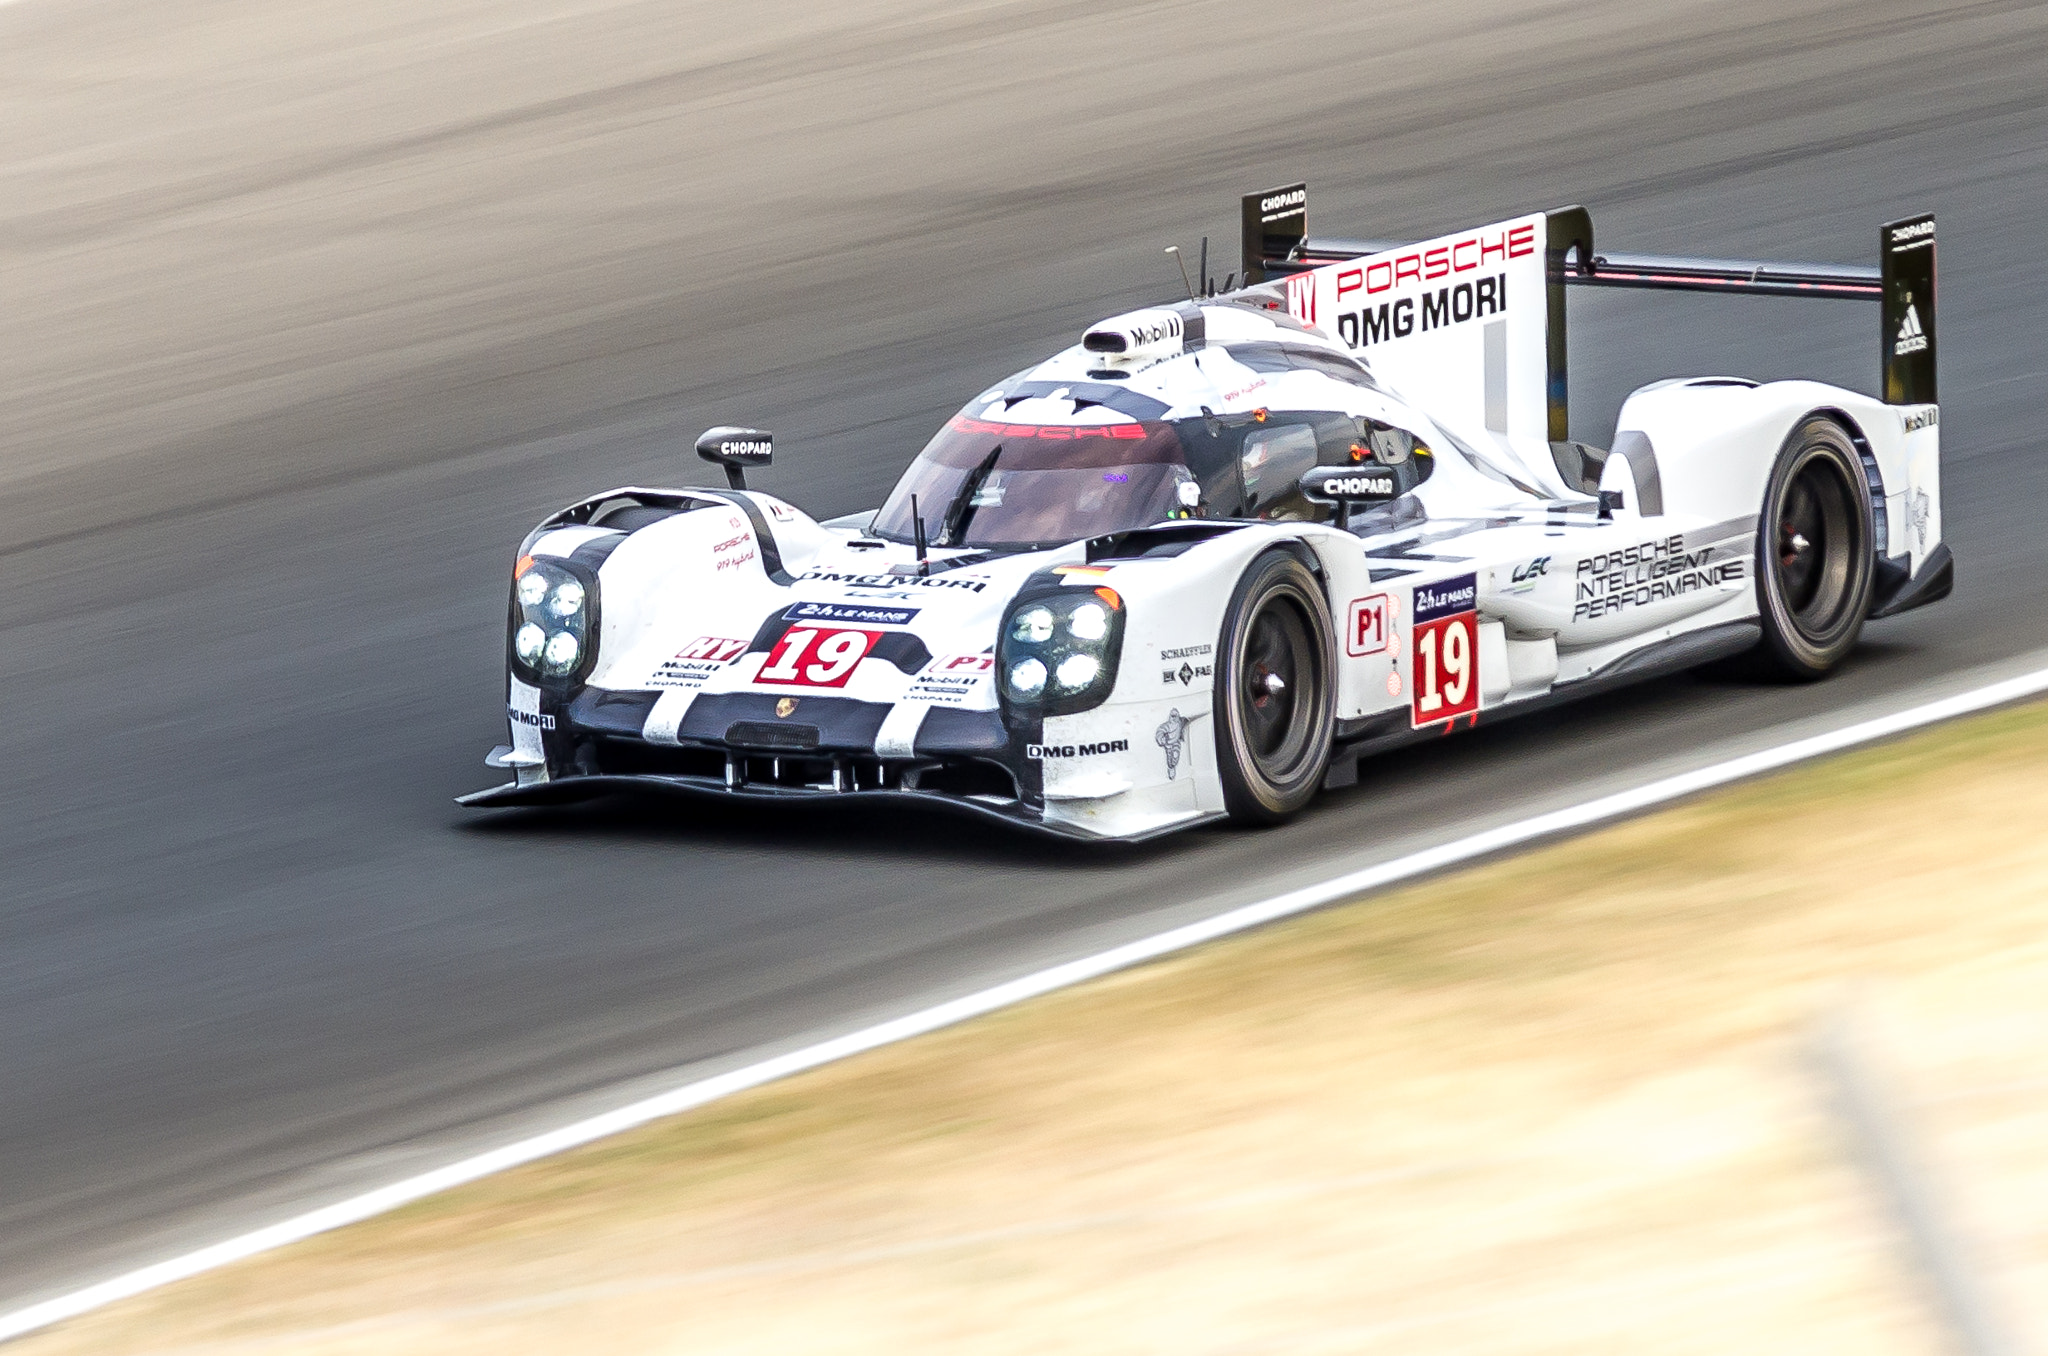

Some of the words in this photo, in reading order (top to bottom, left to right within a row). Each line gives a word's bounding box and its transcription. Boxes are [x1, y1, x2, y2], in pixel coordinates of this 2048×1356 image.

[1261, 189, 1305, 212] CHOPARD
[1337, 224, 1534, 303] PORSCHE
[1287, 273, 1316, 328] HY
[1338, 297, 1414, 350] DMG
[1421, 272, 1507, 332] MORI
[1130, 320, 1167, 348] Mobil
[721, 441, 772, 455] CHOPARD
[1323, 478, 1393, 495] CHOPARD
[1577, 534, 1684, 579] PORSCHE
[800, 571, 887, 586] DMG
[887, 574, 987, 593] MORI
[1576, 547, 1716, 602] INTELLIGENT
[1435, 593, 1447, 607] LE
[1447, 586, 1474, 603] MANS
[1357, 604, 1382, 646] P1
[678, 637, 747, 660] HY
[758, 628, 869, 683] 19
[946, 656, 993, 670] P1
[1419, 621, 1471, 712] 19
[520, 711, 554, 728] MORI
[1028, 744, 1076, 758] DMG
[1078, 739, 1129, 756] MORI
